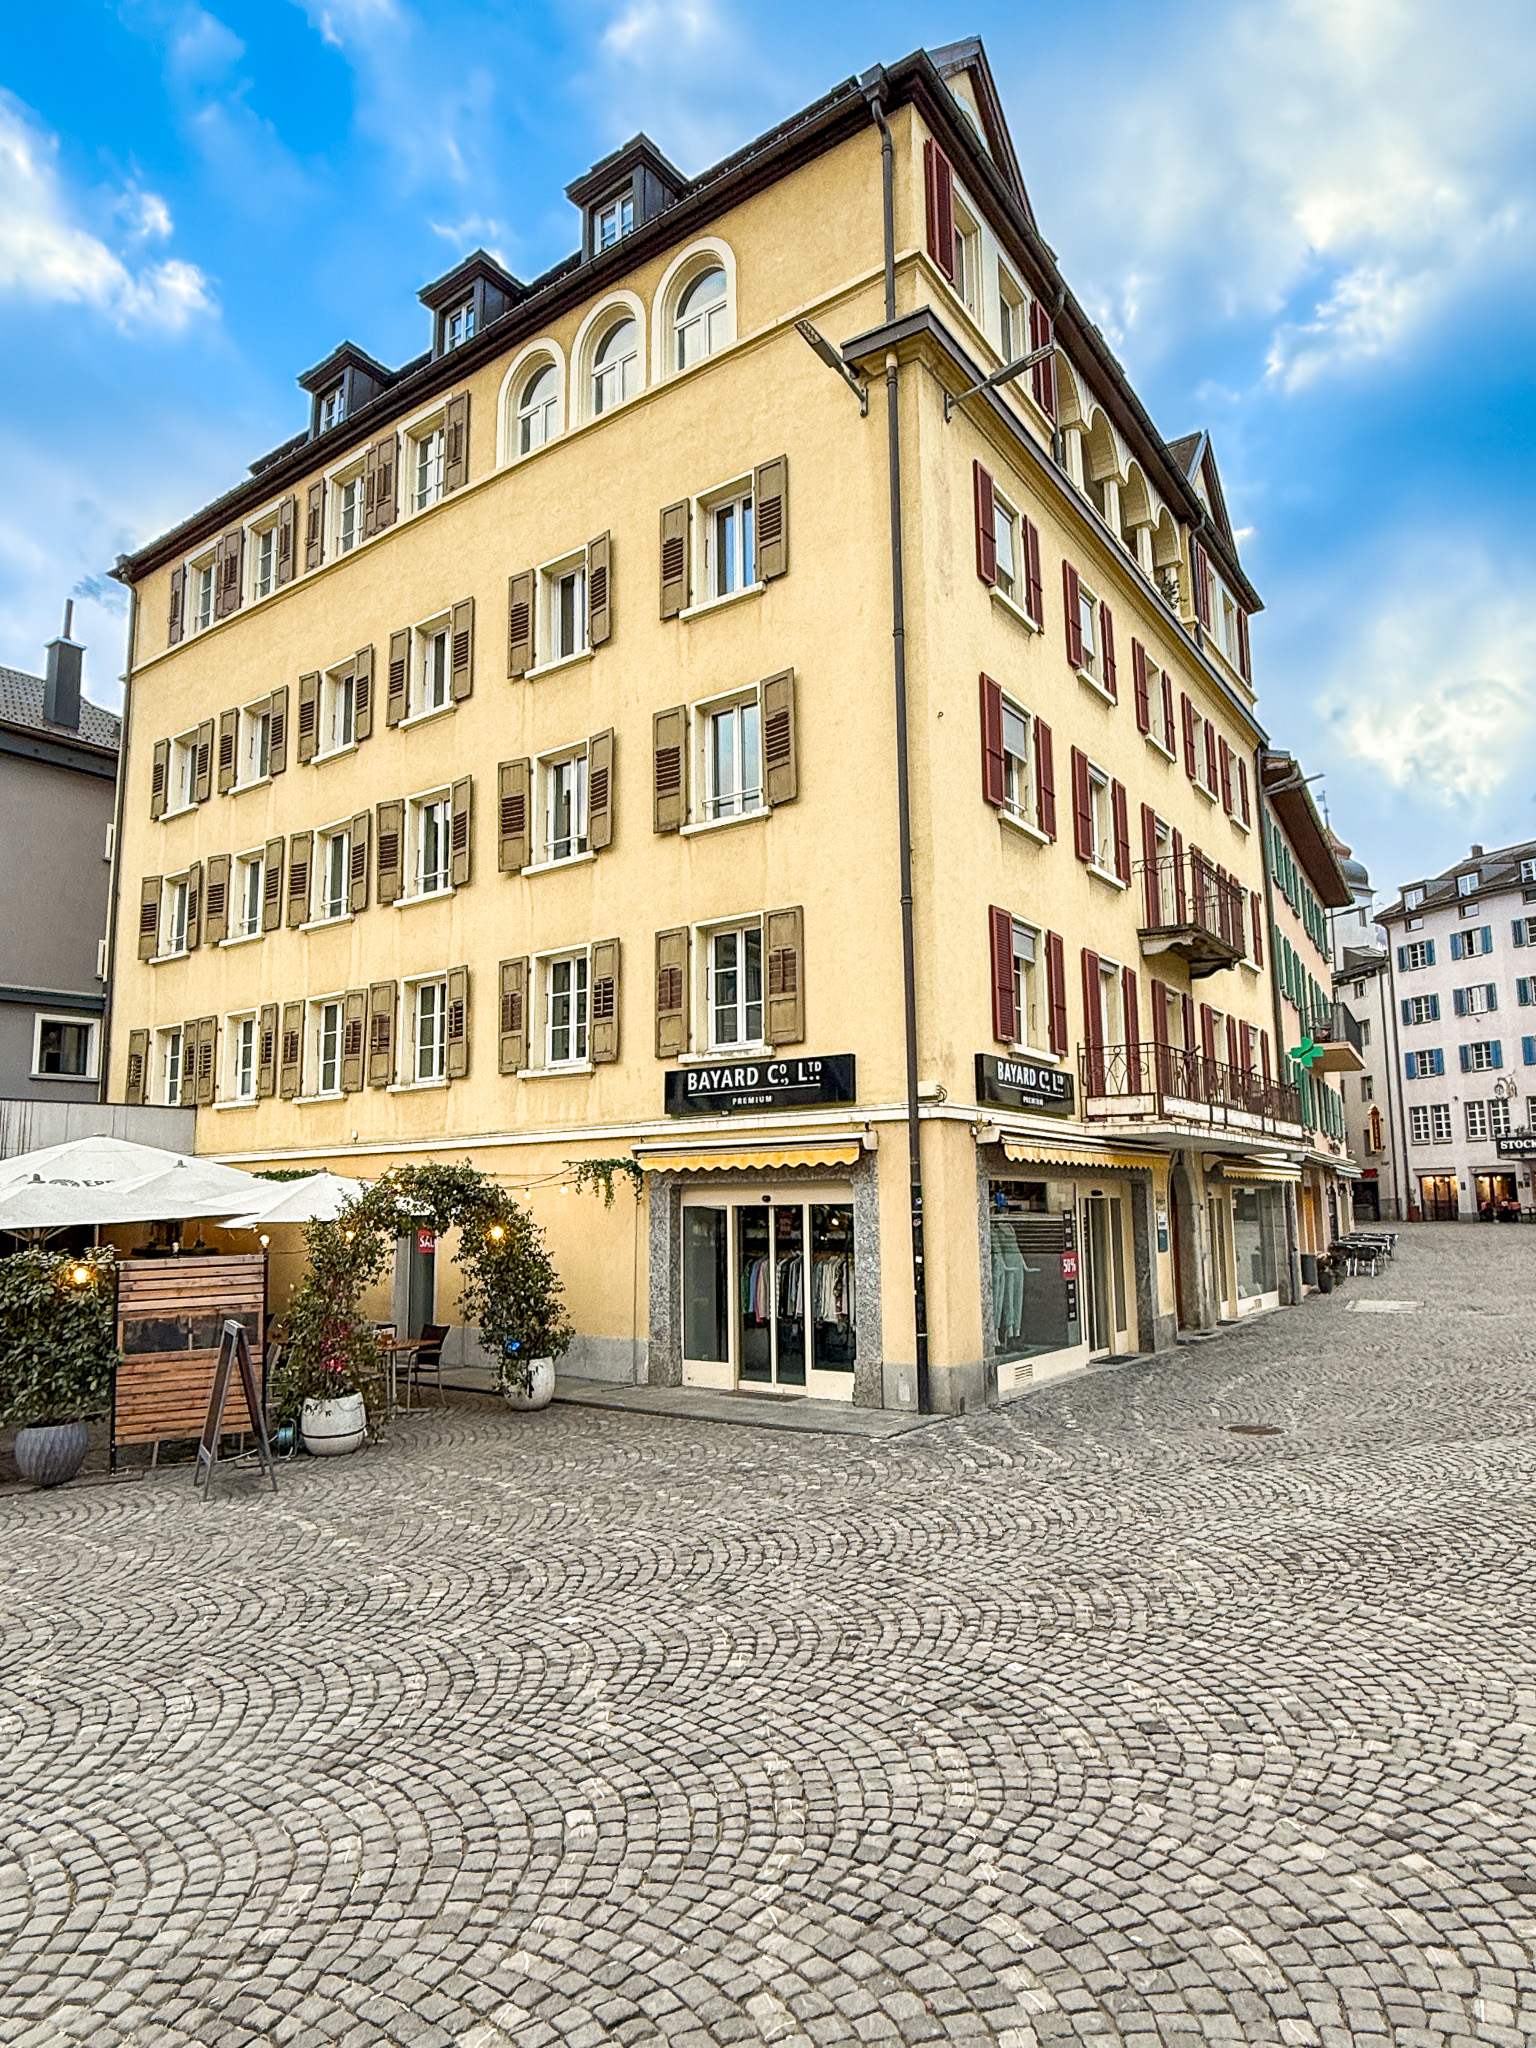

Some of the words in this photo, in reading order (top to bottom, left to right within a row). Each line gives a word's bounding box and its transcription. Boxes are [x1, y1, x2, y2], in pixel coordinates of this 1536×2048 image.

[687, 1067, 759, 1091] BAYARD
[997, 1060, 1037, 1087] BAYARD
[732, 1095, 773, 1105] PREMIUM
